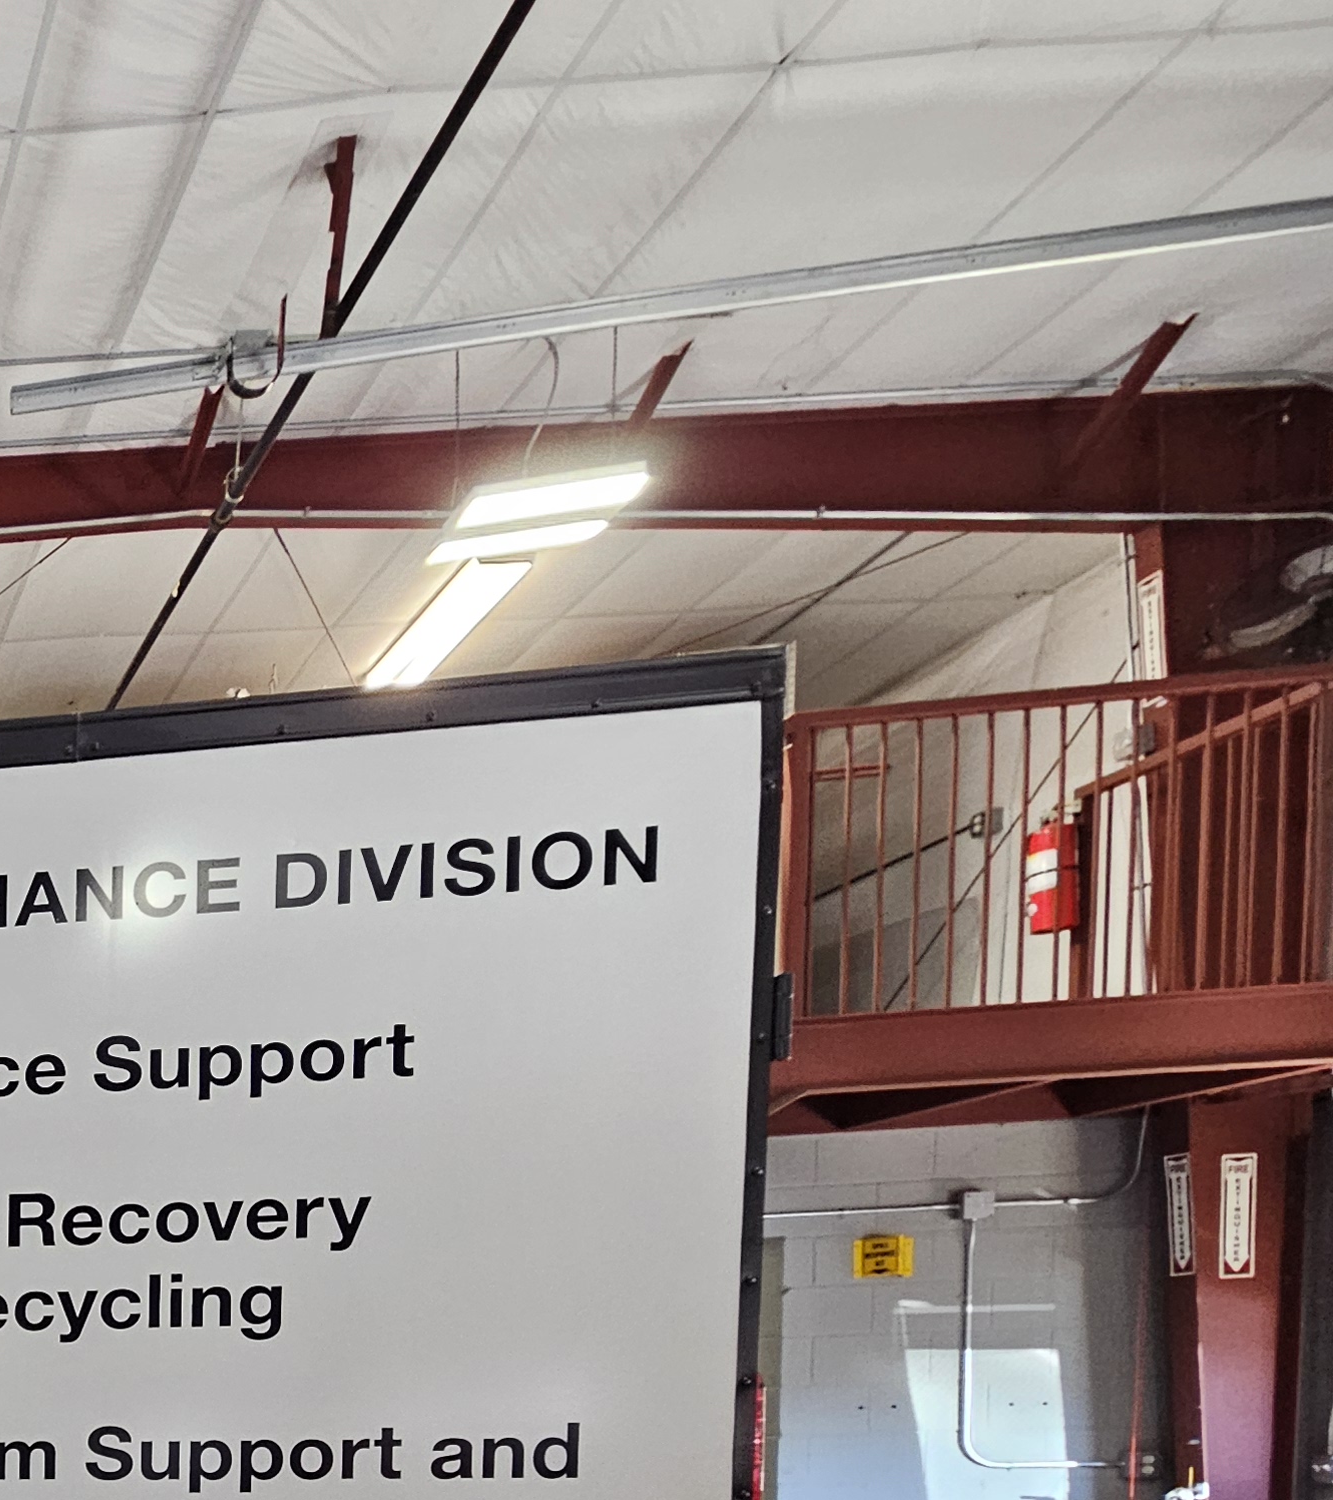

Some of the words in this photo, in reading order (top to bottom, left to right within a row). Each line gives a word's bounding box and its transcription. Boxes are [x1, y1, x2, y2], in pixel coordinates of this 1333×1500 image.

[274, 825, 659, 909] DIVISION
[93, 1024, 415, 1100] Support
[7, 1192, 372, 1252] Recovery
[85, 1424, 402, 1494] Support
[430, 1422, 582, 1480] and
